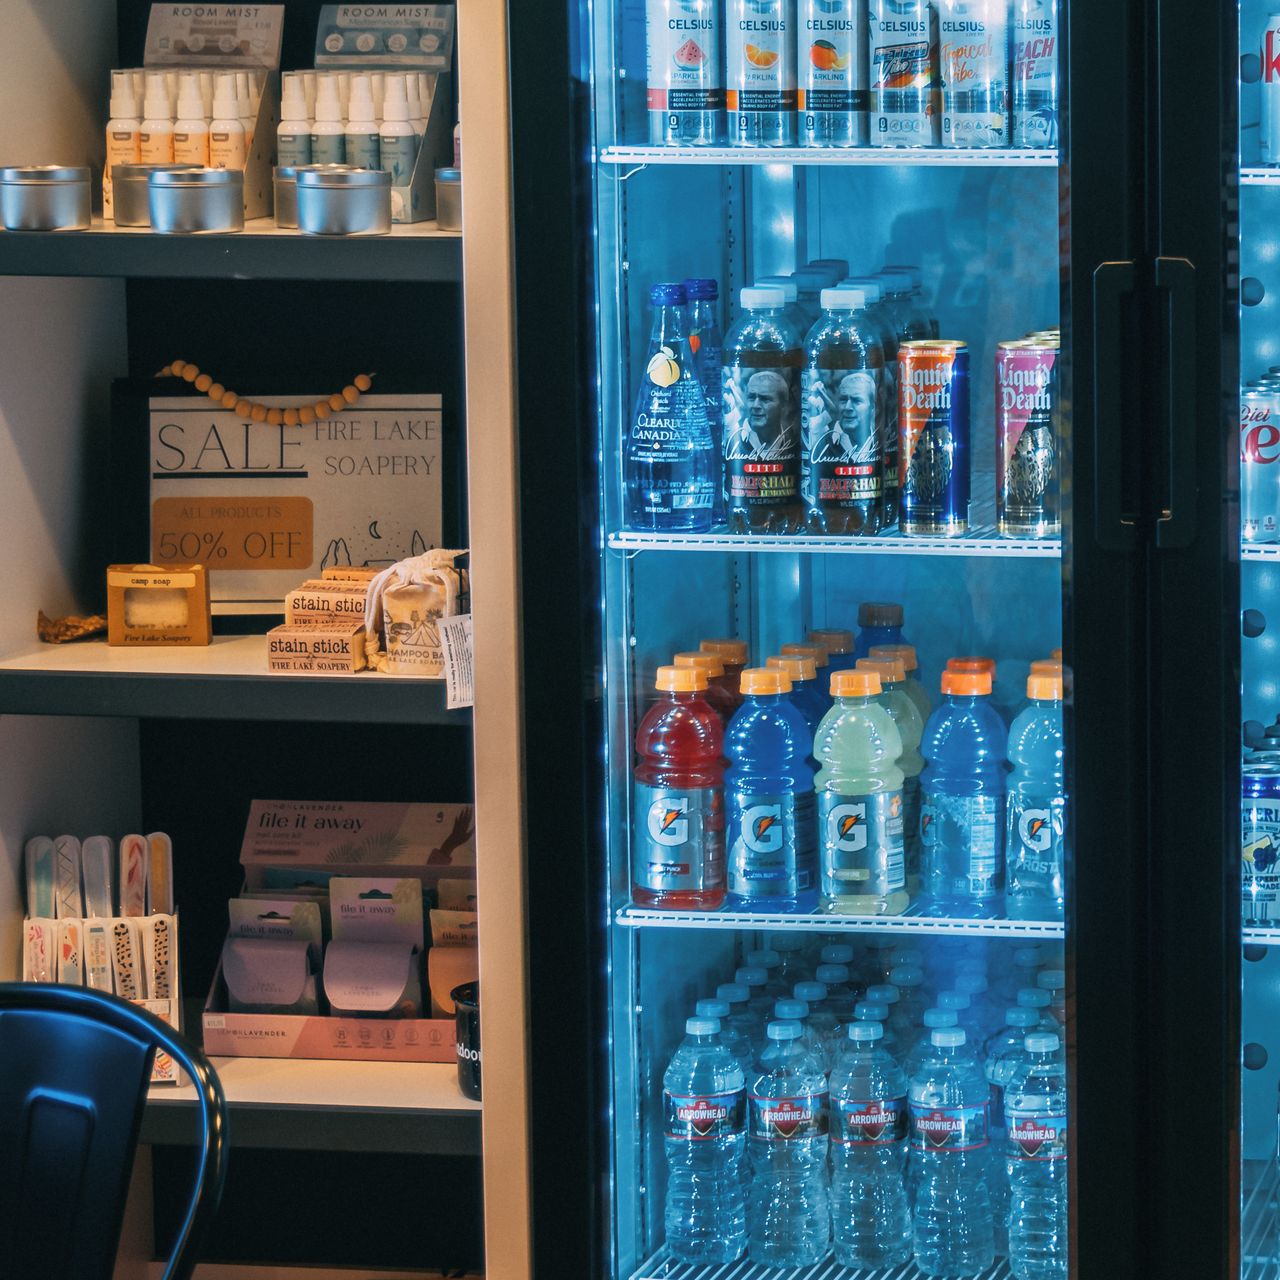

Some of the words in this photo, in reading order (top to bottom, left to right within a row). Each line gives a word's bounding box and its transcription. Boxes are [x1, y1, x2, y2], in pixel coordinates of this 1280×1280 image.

[173, 7, 218, 17] ROOM
[226, 8, 260, 18] MIST
[342, 7, 389, 18] ROOM
[396, 8, 430, 18] MIST
[669, 19, 712, 29] CELSIUS
[739, 20, 785, 31] CELSIUS
[807, 20, 853, 30] CELSIUS
[880, 21, 926, 31] CELSIUS
[941, 34, 992, 61] Tropical
[900, 361, 951, 392] Liquid
[998, 362, 1050, 392] Liquid
[902, 387, 951, 410] Death
[1001, 387, 1051, 410] Death
[314, 420, 362, 441] FIRE
[373, 420, 436, 441] LAKE
[155, 422, 305, 472] SALE
[324, 455, 436, 476] SOAPERY
[747, 464, 779, 472] LITE
[839, 467, 870, 475] LITE
[180, 507, 205, 519] ALL
[210, 506, 282, 519] PRODUCTS
[159, 530, 228, 560] 50%
[243, 531, 302, 559] OFF
[292, 596, 330, 611] stain
[270, 639, 308, 653] stain
[313, 639, 349, 654] stick
[272, 662, 290, 670] FIRE
[293, 662, 313, 670] LAKE
[317, 662, 351, 671] SOAPERY
[259, 812, 289, 829] file
[294, 813, 306, 828] it
[314, 816, 364, 833] away
[648, 797, 689, 846] G
[741, 803, 783, 853] G
[827, 802, 868, 852] G
[341, 904, 358, 913] file
[360, 904, 366, 913] it
[369, 906, 396, 916] away
[679, 1108, 726, 1120] ARROWHEAD
[850, 1113, 896, 1125] ARROWHEAD
[917, 1120, 962, 1131] ARROWHEAD
[1010, 1130, 1055, 1140] ARROWHEAD
